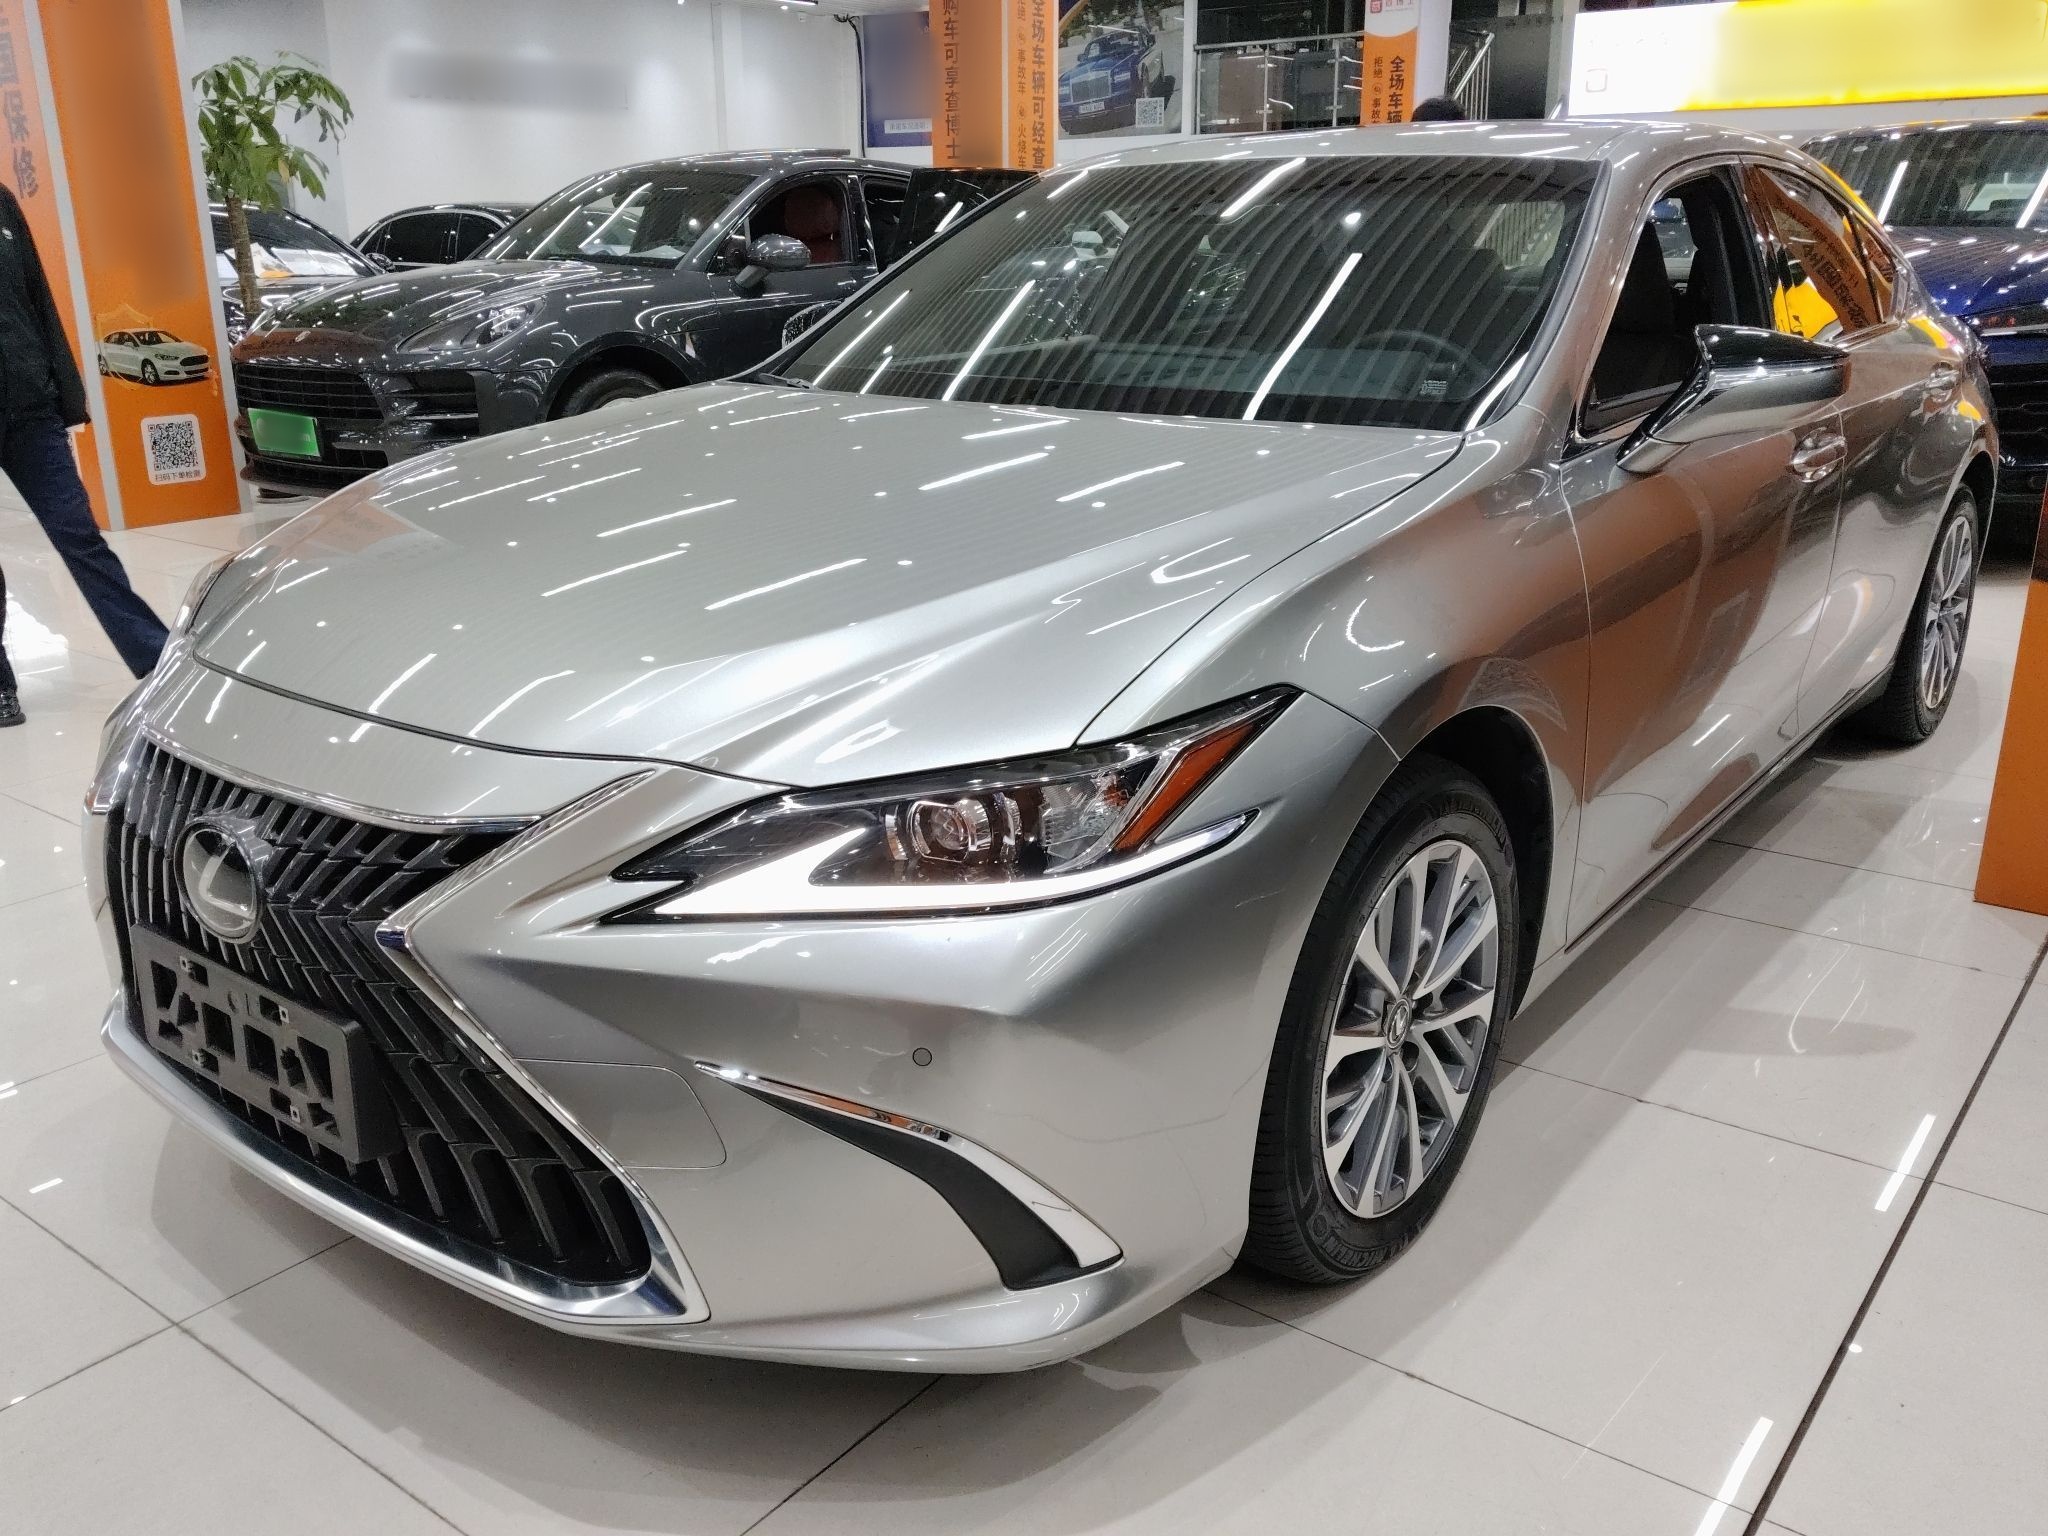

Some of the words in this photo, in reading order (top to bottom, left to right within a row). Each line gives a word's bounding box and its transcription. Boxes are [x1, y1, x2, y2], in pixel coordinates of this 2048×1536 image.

[0, 5, 39, 199] 国保修
[1371, 98, 1381, 124] 事故
